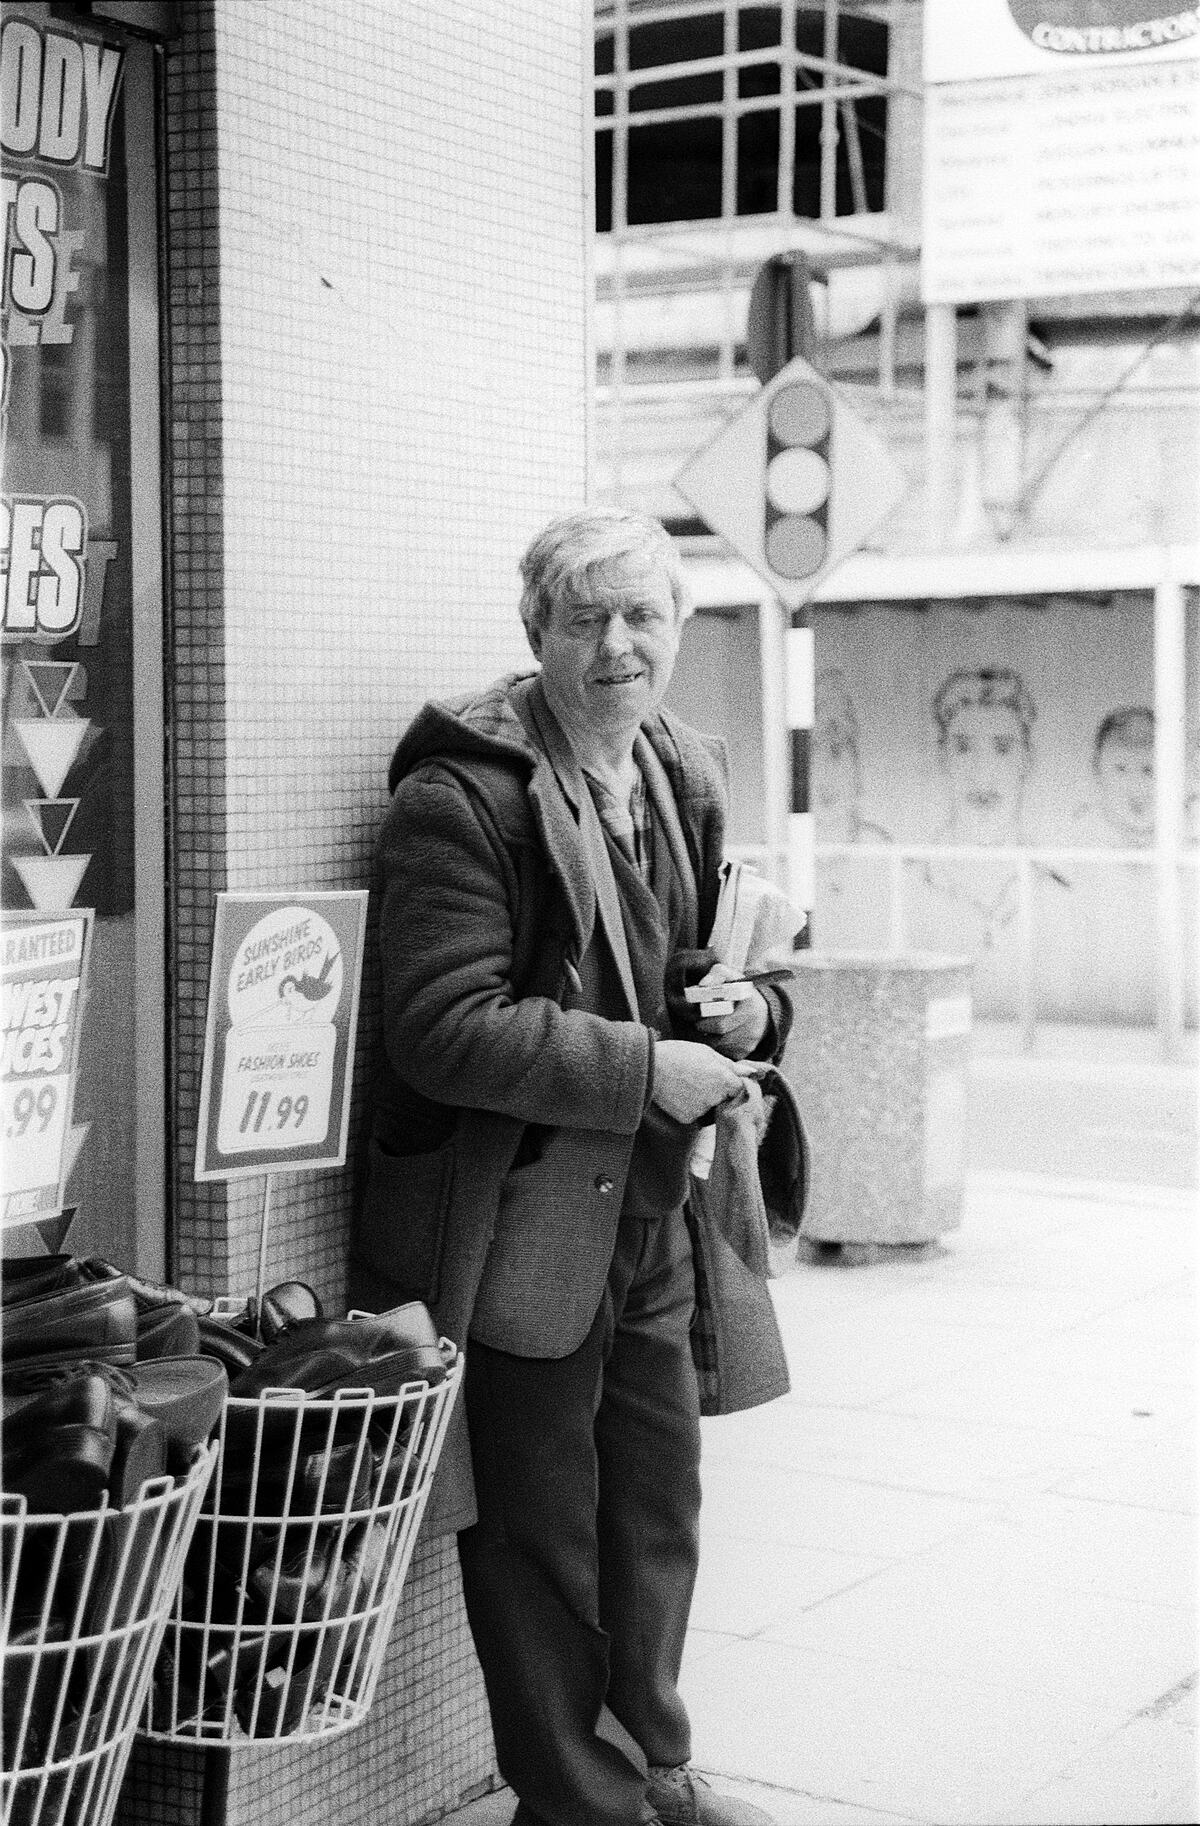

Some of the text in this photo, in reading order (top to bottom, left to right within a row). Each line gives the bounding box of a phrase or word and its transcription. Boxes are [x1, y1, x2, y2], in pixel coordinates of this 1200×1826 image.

[1031, 8, 1200, 52] CONTRACTOR
[1, 928, 76, 966] RANTEED
[237, 935, 323, 992] EARLY BIRDS
[243, 918, 312, 966] SUNSHINE
[0, 1023, 69, 1074] ICES
[237, 1051, 321, 1073] FASHION SHOES
[239, 1090, 310, 1134] 11.99
